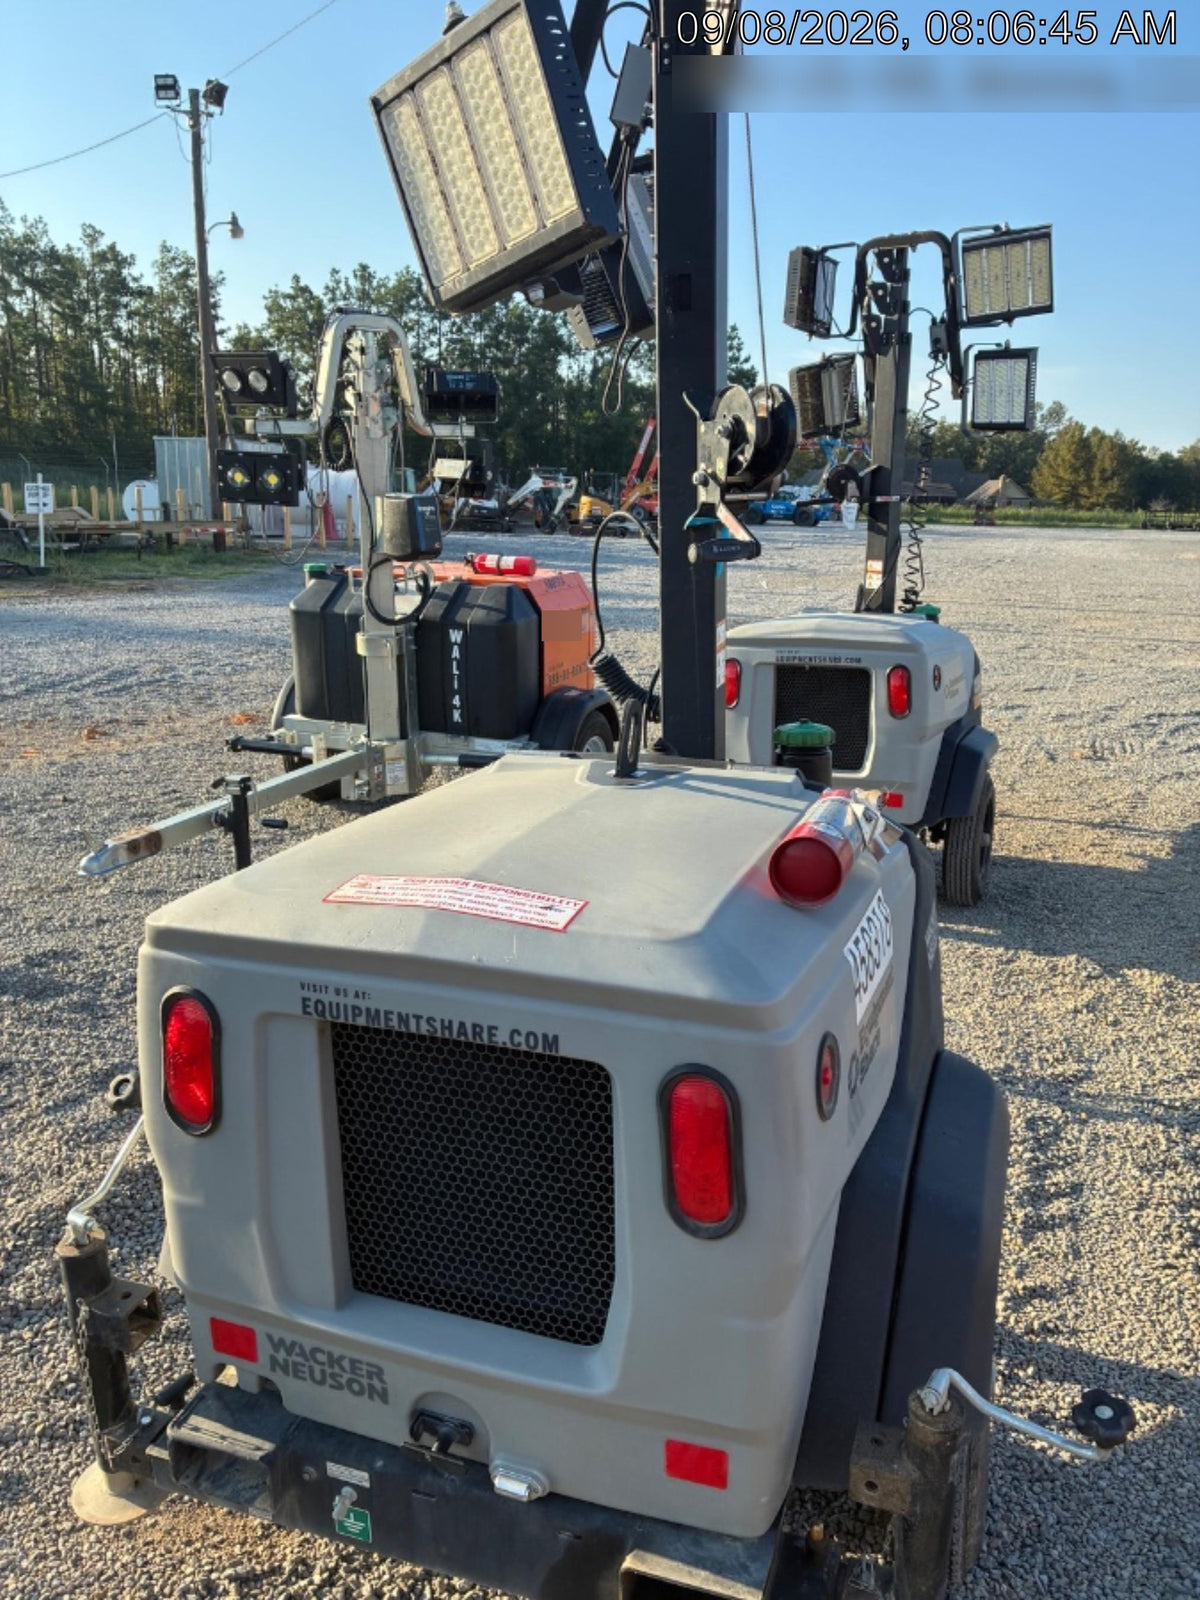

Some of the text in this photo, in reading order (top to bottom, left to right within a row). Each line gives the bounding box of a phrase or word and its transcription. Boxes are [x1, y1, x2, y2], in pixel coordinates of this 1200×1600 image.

[300, 982, 371, 1001] VISIT US AT:
[301, 996, 560, 1054] EQUIPMENTSHARE.COM
[265, 1332, 387, 1386] WACKER
[269, 1353, 389, 1406] NEUSON
